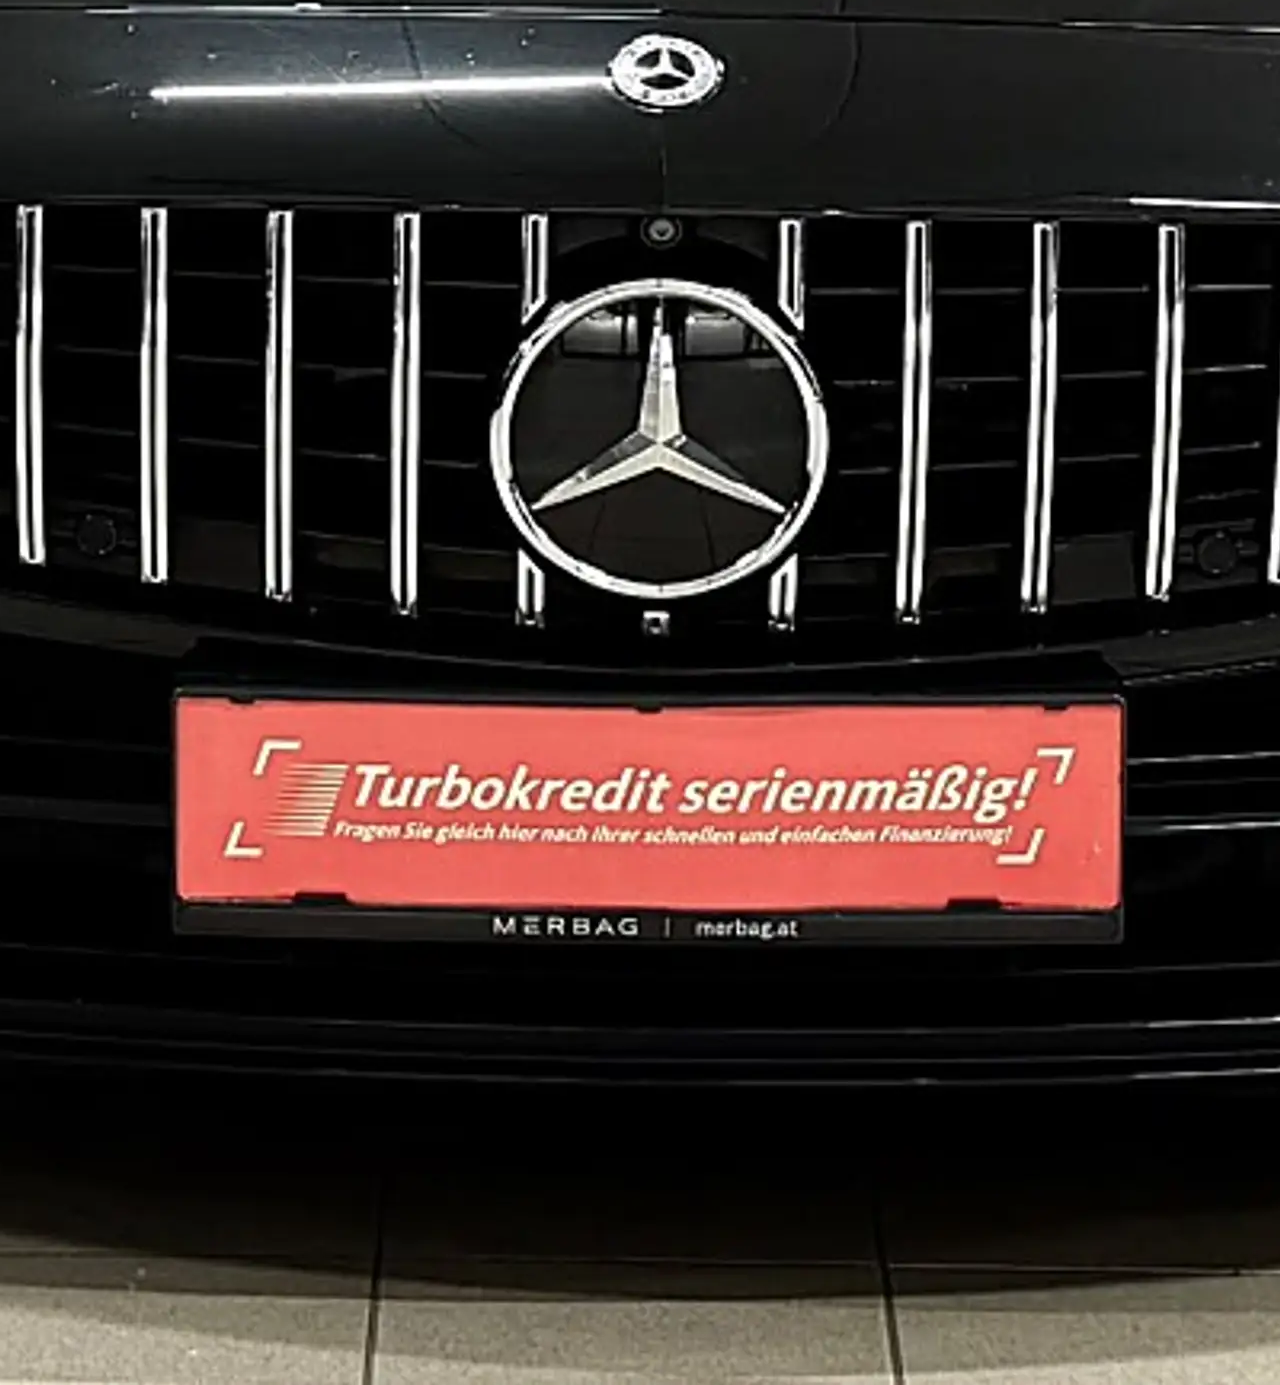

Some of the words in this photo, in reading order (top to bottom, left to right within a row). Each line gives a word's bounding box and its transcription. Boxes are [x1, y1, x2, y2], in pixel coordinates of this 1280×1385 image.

[354, 763, 672, 813] Turbokredit
[678, 764, 1039, 824] serienmäßig!
[333, 820, 401, 843] Fragen
[404, 822, 432, 840] Sie
[435, 822, 495, 845] gleich
[497, 823, 538, 842] hier
[540, 824, 587, 843] nach
[643, 825, 735, 844] schnellen
[738, 826, 778, 844] und
[780, 825, 875, 844] einfachen
[879, 825, 1013, 845] Finanzierung!
[492, 917, 638, 936] MERBAG
[695, 918, 798, 941] merbag.at
